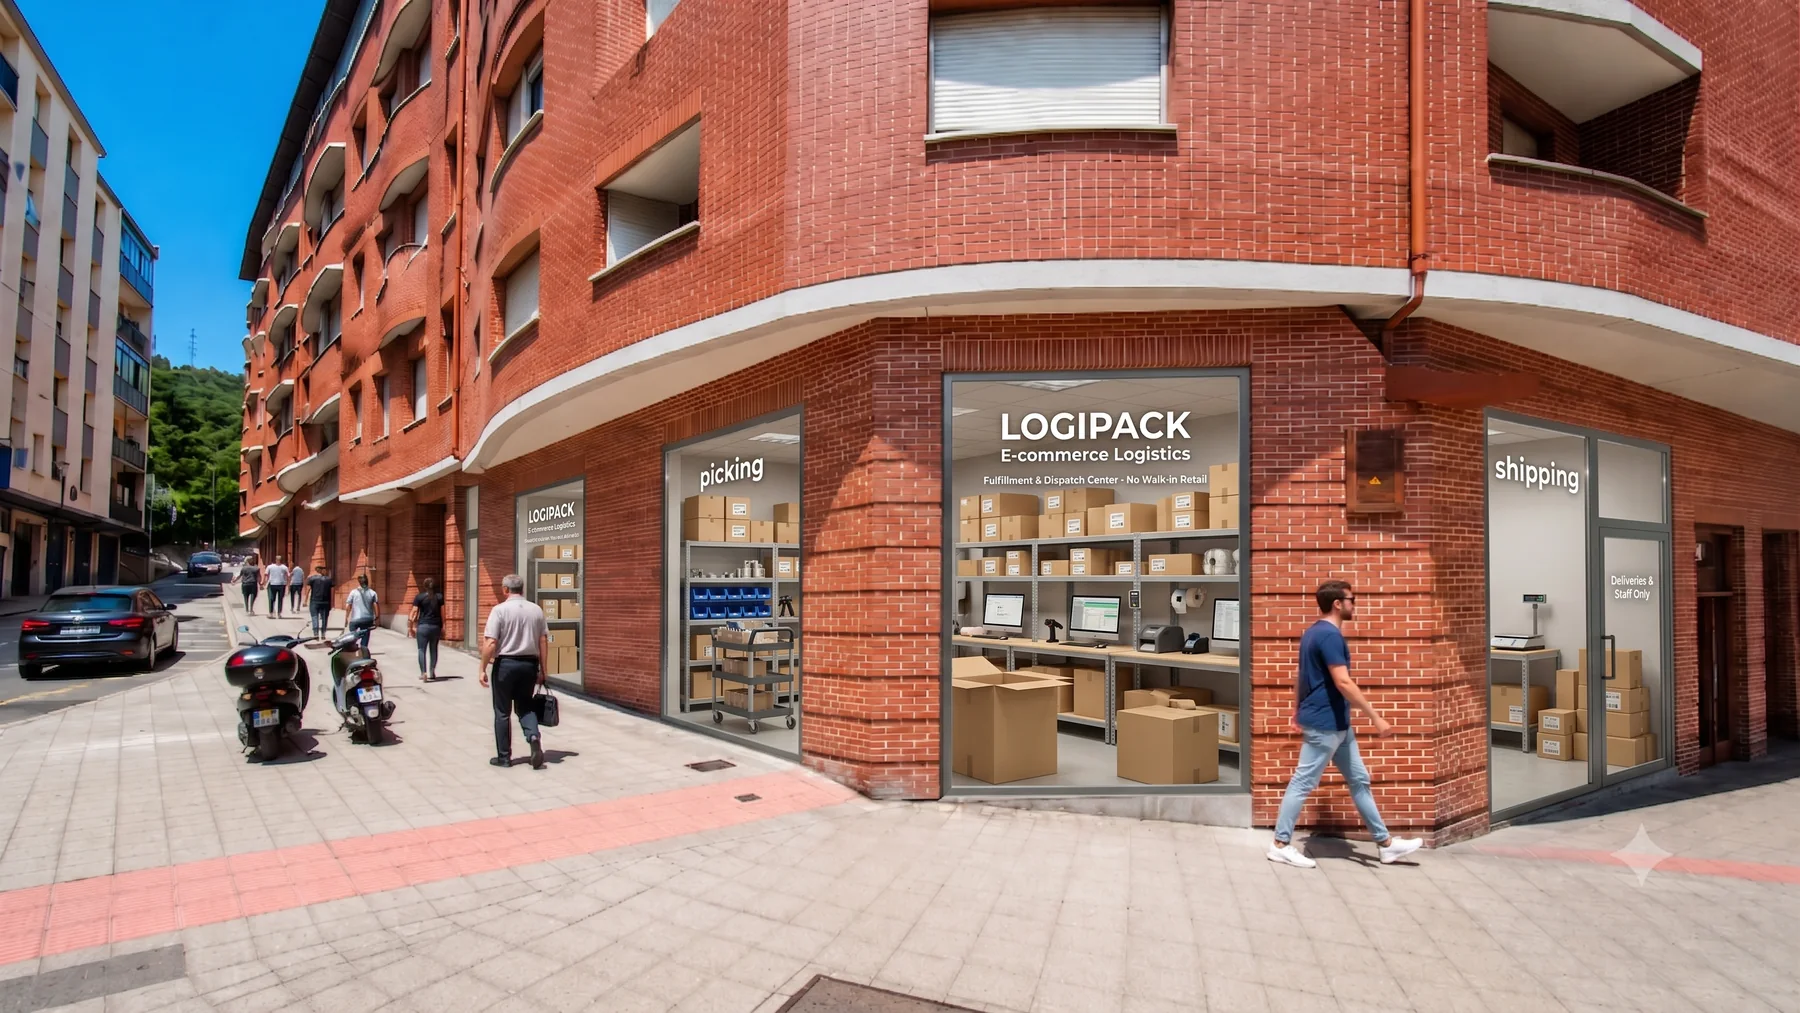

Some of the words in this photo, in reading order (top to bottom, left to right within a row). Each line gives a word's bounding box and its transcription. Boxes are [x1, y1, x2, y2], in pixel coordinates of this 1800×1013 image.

[1001, 411, 1191, 441] LOGIPACK
[1001, 448, 1109, 462] E-commerce
[1114, 445, 1191, 465] Logistics
[700, 456, 764, 492] picking
[983, 476, 1034, 485] Fulfillment
[1035, 476, 1042, 485] &
[1044, 475, 1085, 487] Dispatch
[1087, 475, 1119, 485] Center
[1126, 475, 1140, 484] No
[1141, 475, 1178, 484] Walk-in
[1180, 474, 1208, 484] Retail
[1495, 455, 1579, 494] shipping
[528, 501, 575, 524] LOGIPACK
[1611, 575, 1647, 586] Deliveries
[1648, 575, 1654, 586] &
[1614, 588, 1633, 599] Staff
[1633, 589, 1651, 601] Only
